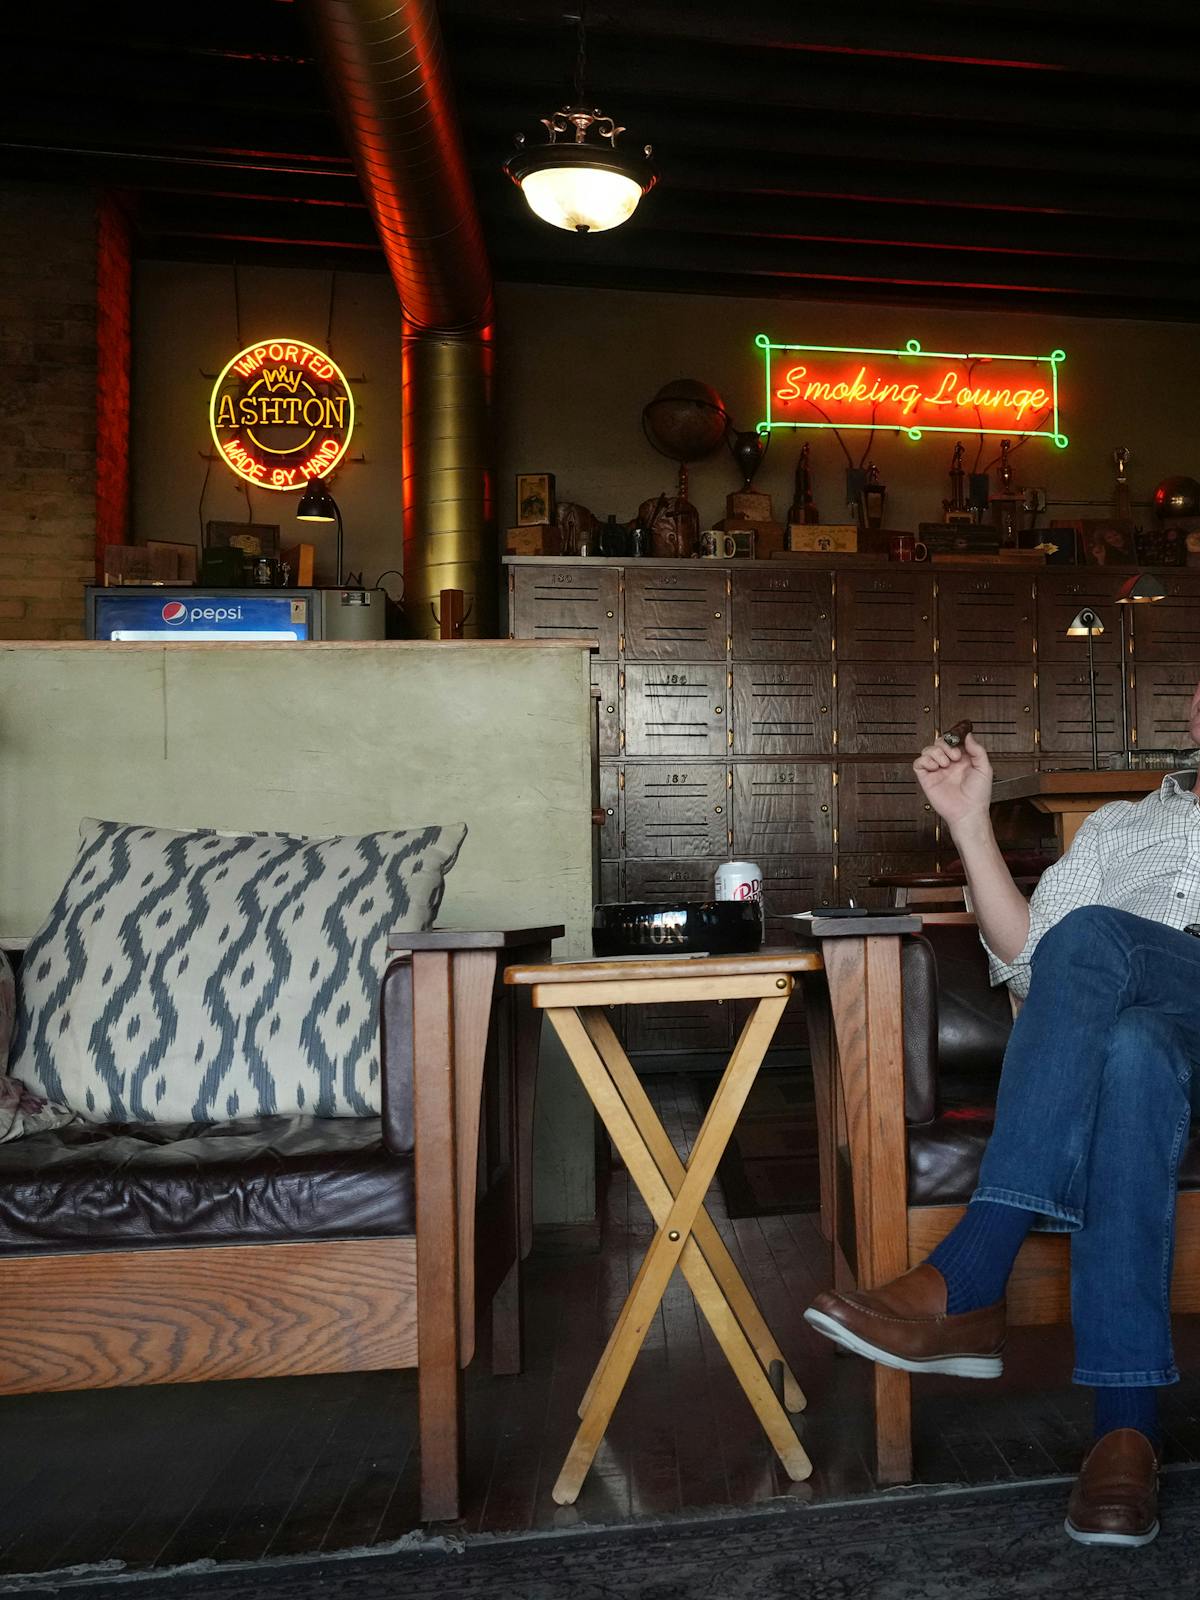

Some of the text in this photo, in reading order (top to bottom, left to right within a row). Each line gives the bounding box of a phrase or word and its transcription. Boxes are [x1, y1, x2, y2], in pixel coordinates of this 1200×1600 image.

[233, 343, 335, 379] IMPORTED
[777, 366, 1050, 420] Smoking Lounge
[215, 394, 348, 429] ASHTON
[222, 439, 340, 486] MADE BY HAND
[190, 606, 241, 623] pepsi
